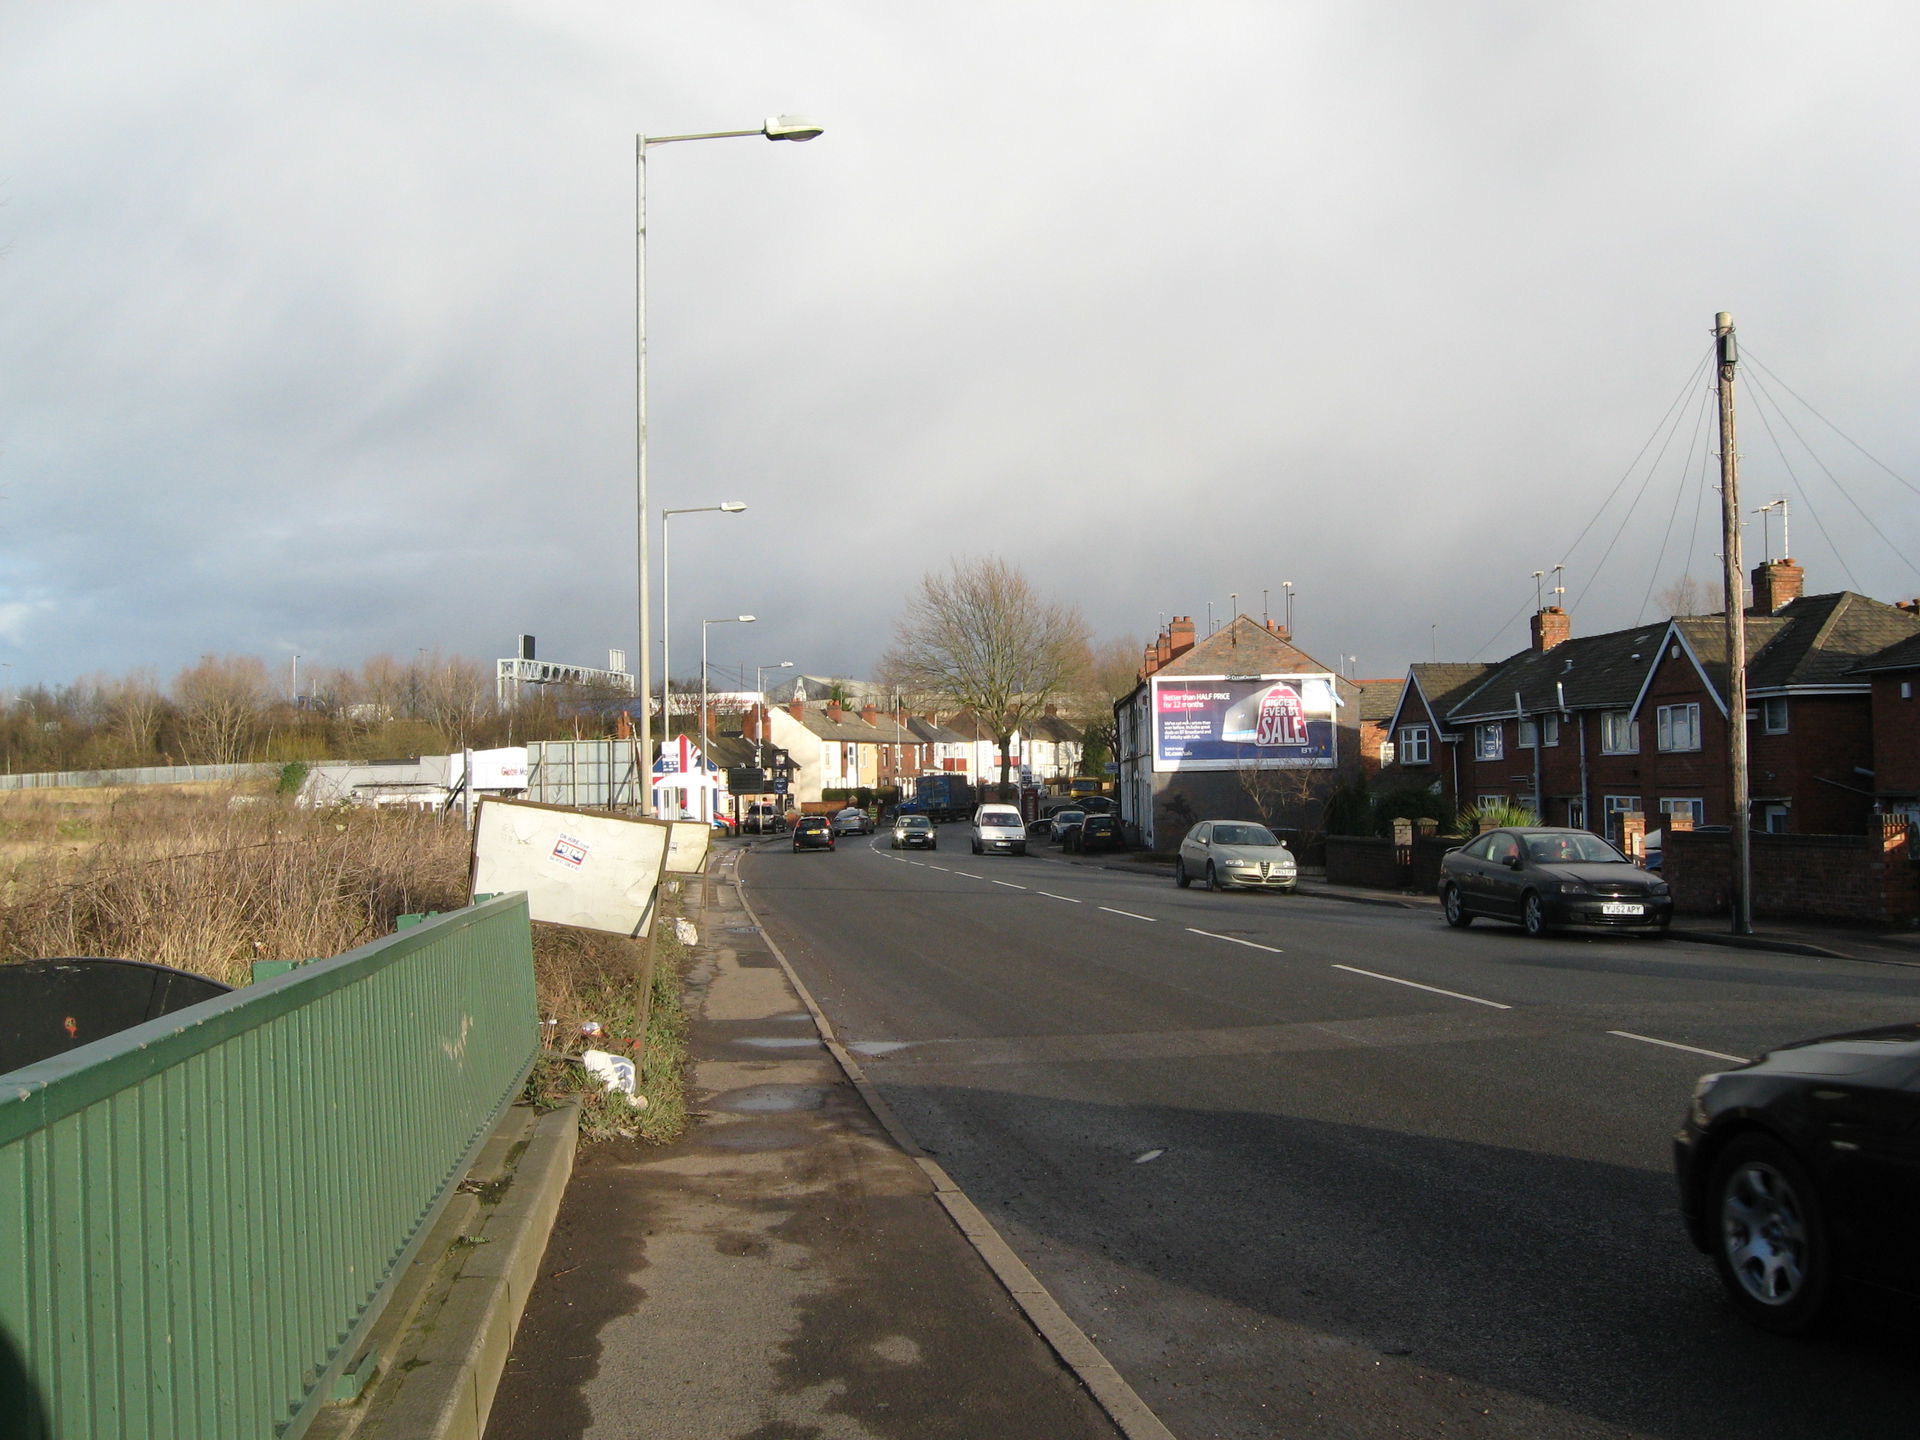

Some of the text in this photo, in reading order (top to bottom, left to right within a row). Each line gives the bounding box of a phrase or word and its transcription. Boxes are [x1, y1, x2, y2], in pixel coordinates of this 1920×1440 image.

[1264, 699, 1297, 707] BIGGEST
[1263, 707, 1300, 717] EVER BT
[1258, 716, 1306, 744] SALE
